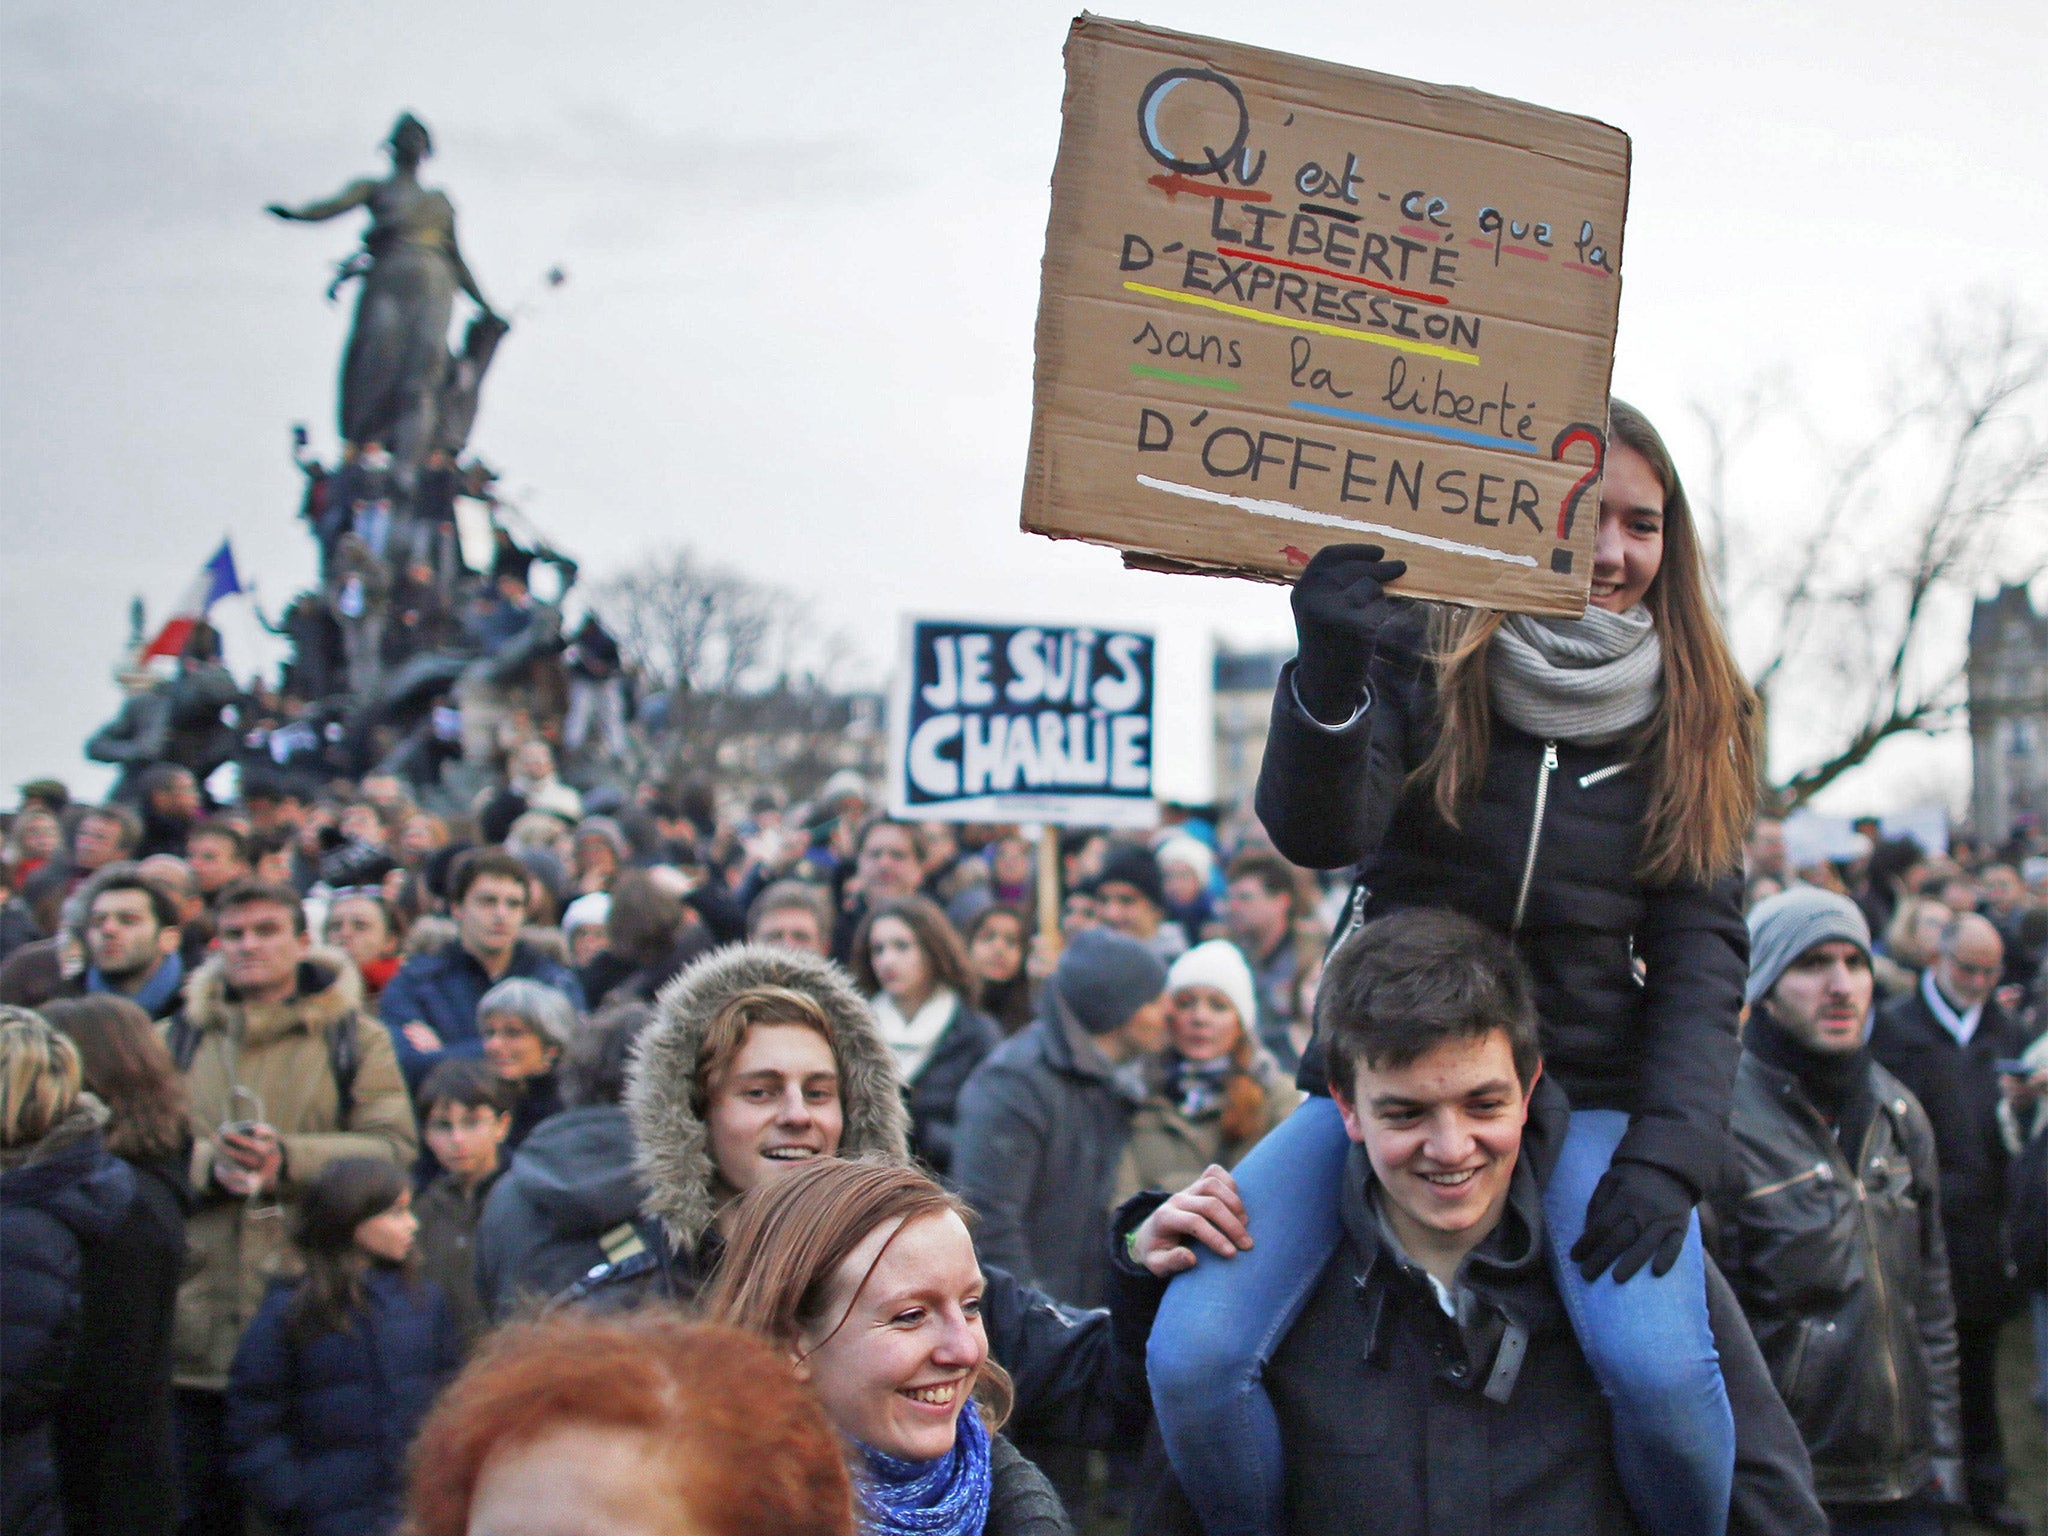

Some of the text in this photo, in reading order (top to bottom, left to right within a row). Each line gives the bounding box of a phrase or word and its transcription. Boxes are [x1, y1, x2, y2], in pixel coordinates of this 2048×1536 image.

[1211, 196, 1459, 288] LIBERTÉ
[1478, 206, 1553, 267] que
[1574, 220, 1613, 273] la
[1119, 233, 1481, 349] D'EXPRESSION
[1132, 321, 1538, 441] sans la liberté
[921, 634, 995, 709] JE
